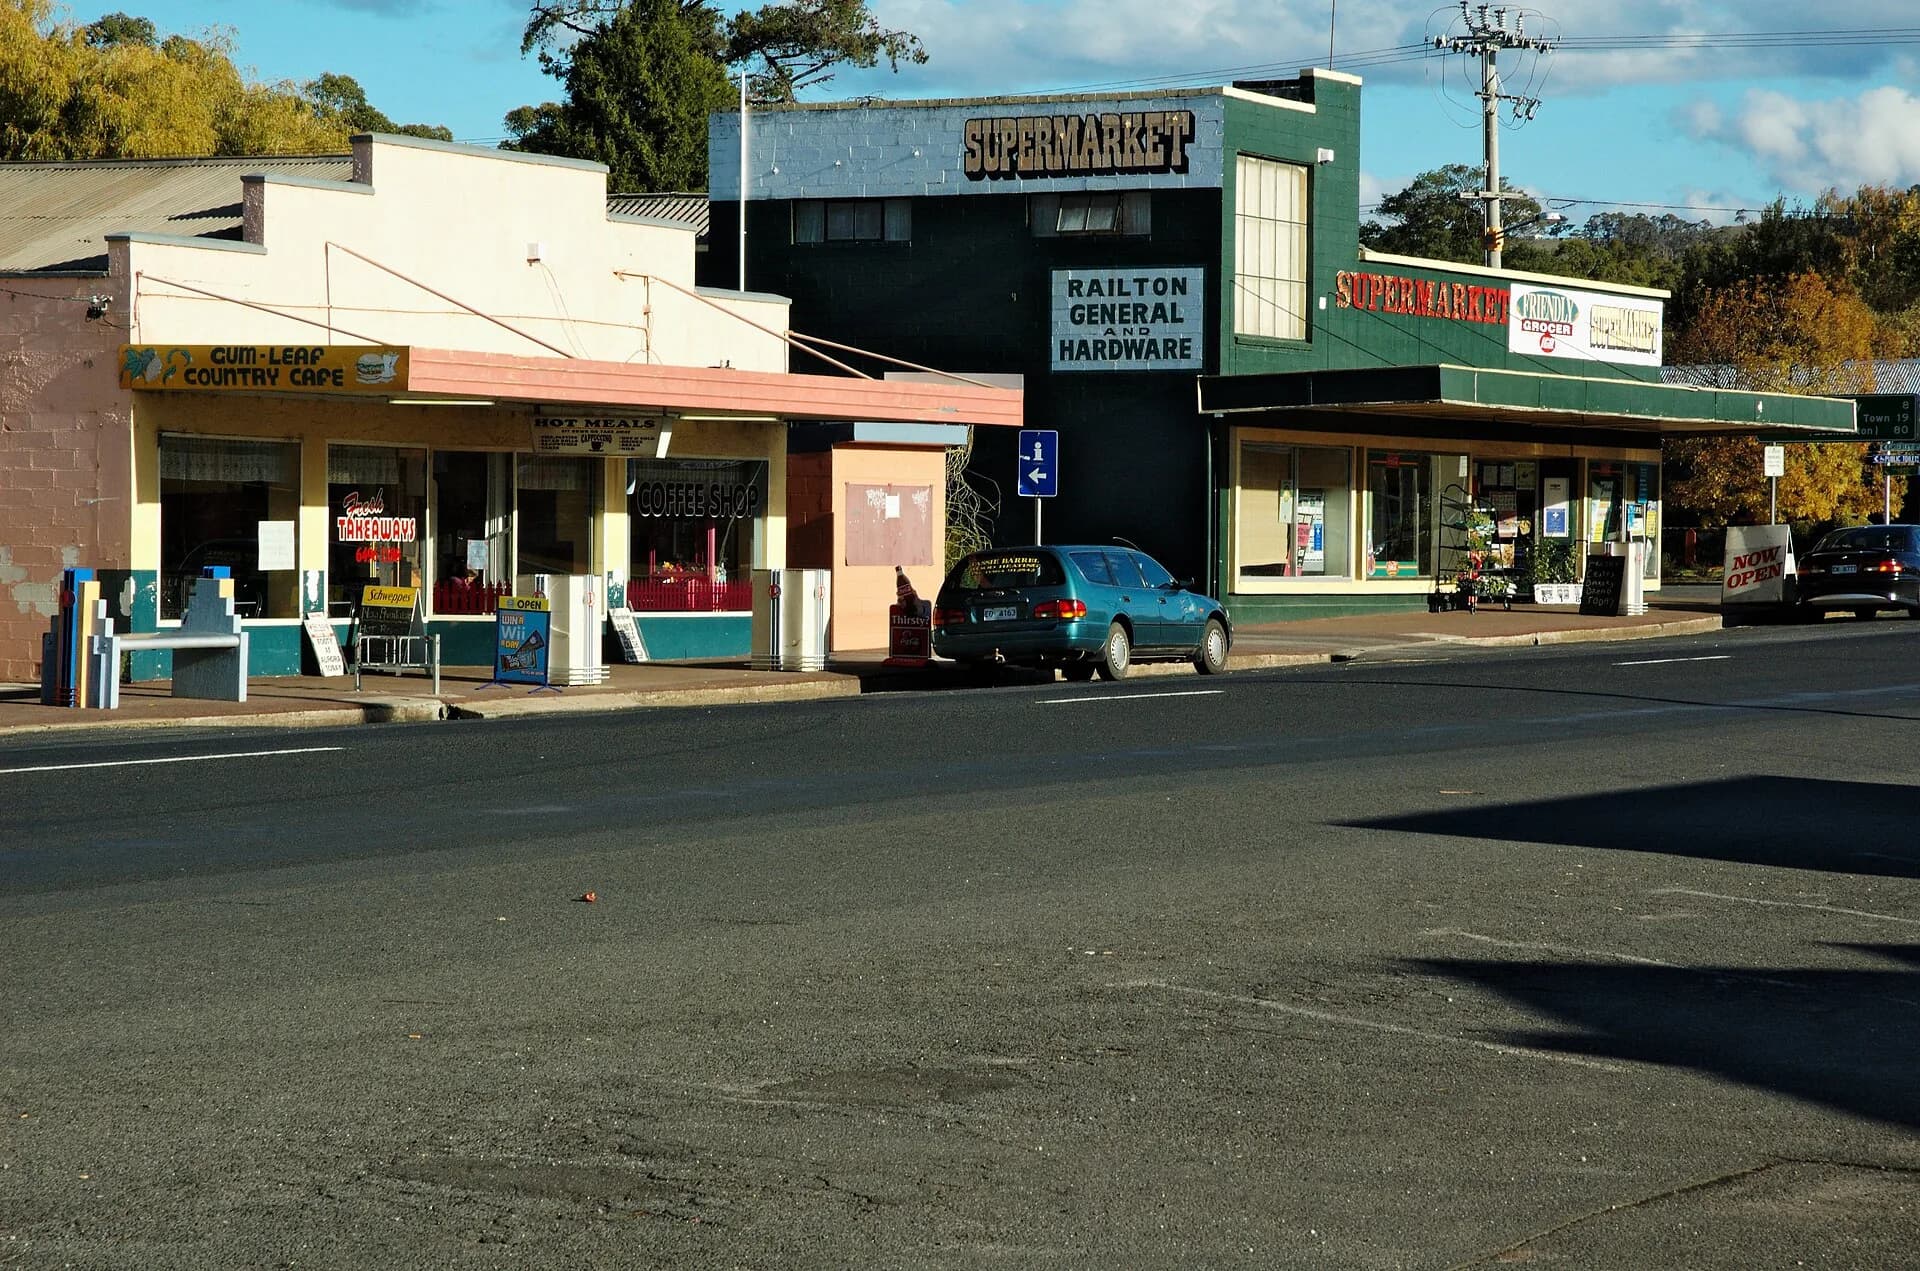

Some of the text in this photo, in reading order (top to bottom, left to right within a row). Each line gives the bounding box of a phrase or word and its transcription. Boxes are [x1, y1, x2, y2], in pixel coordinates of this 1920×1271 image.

[964, 110, 1196, 181] SUPERMARKET
[1067, 277, 1187, 298] RAILTON
[1336, 270, 1510, 325] SUPERMARKET
[1069, 302, 1185, 325] GENERAL
[1522, 292, 1574, 324] FRIENDLY
[1103, 327, 1150, 336] AND
[1522, 321, 1572, 336] GROCER
[1058, 337, 1192, 361] HARDWARE
[183, 368, 344, 386] COUNTRY CAFE
[1902, 401, 1910, 410] 8
[534, 418, 655, 429] HOT MEALS
[1863, 412, 1909, 423] Town 19
[1893, 425, 1909, 435] 80
[343, 487, 384, 518] Fresh
[637, 481, 759, 519] COFFEE SHOP
[337, 516, 416, 543] TAKEAWAYS
[1731, 545, 1782, 571] NOW
[1727, 562, 1785, 589] OPEN
[367, 588, 411, 604] Schweppes
[517, 599, 542, 609] OPEN
[501, 615, 518, 625] WIN
[892, 615, 930, 627] Thirsty?
[501, 626, 525, 640] Wii
[505, 640, 519, 648] DAY
